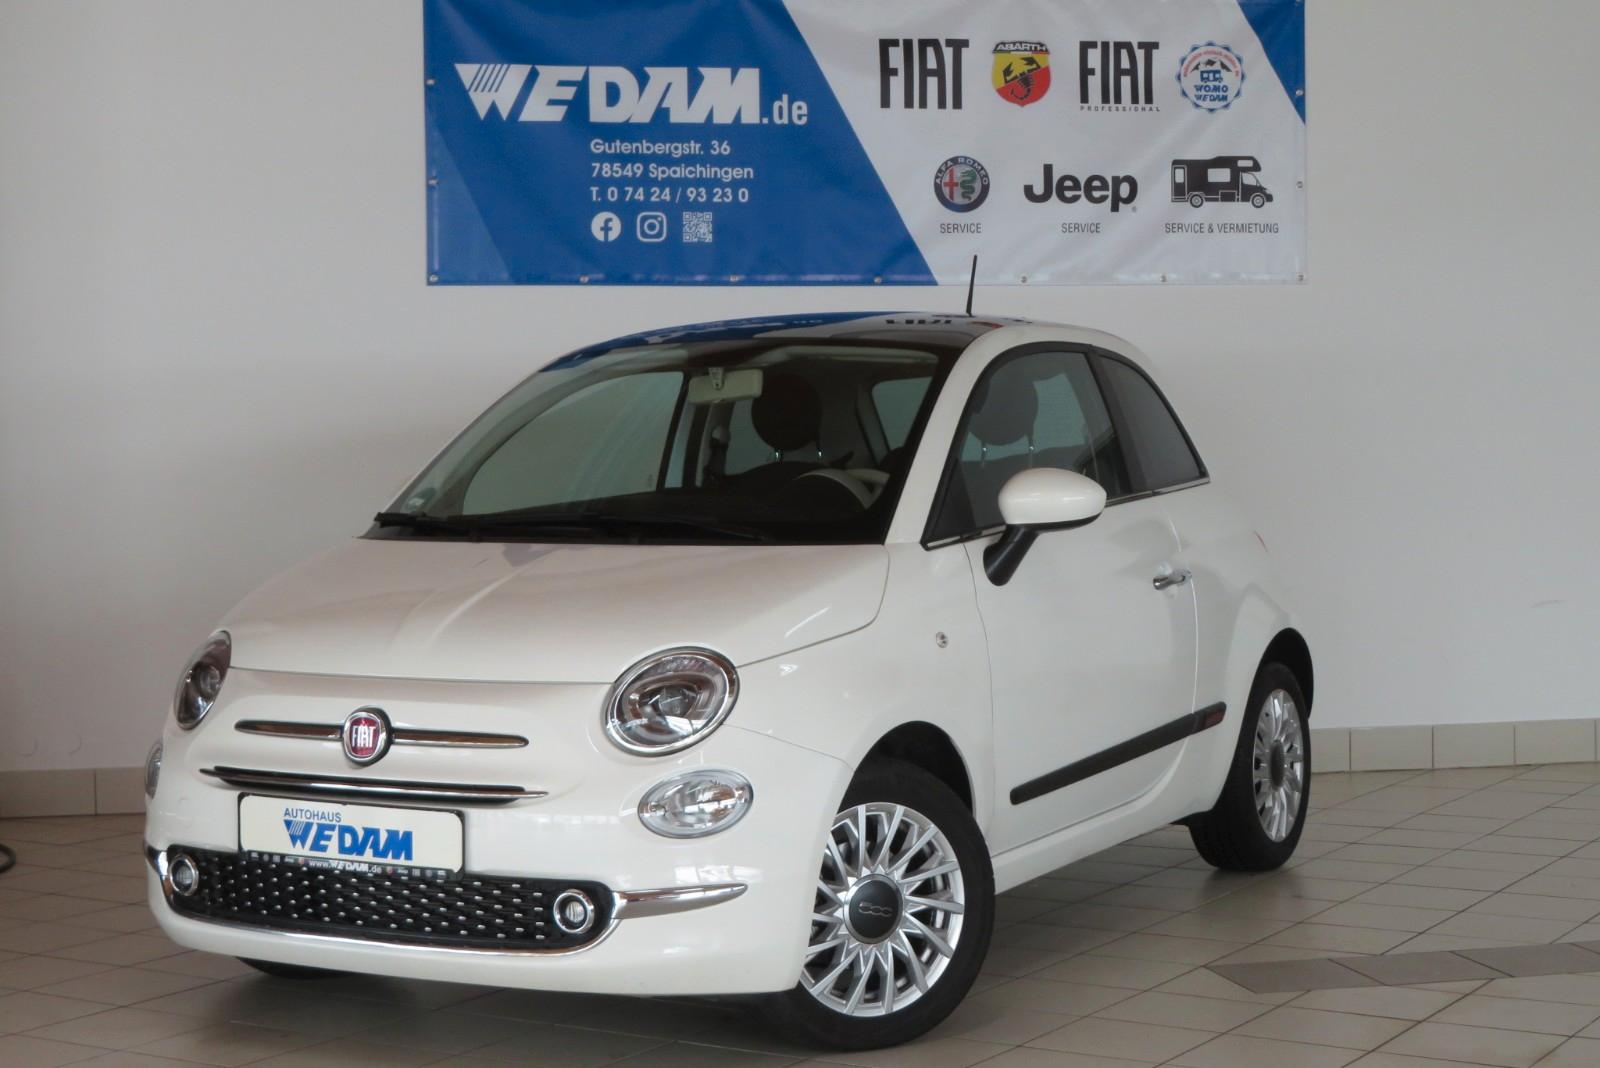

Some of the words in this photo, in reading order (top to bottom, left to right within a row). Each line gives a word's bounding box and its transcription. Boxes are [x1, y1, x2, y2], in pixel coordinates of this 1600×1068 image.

[997, 42, 1048, 52] ABARTH
[878, 38, 970, 110] FIAT
[1079, 40, 1160, 105] FIAT
[590, 139, 704, 158] Gutenbergstr.
[710, 140, 731, 155] 36
[591, 163, 644, 178] 78549
[648, 163, 754, 182] Spaichingen
[935, 160, 954, 184] ALFA
[958, 157, 989, 185] ROMEO
[590, 186, 601, 202] T.
[607, 186, 618, 201] 0
[624, 186, 645, 201] 74
[650, 187, 671, 201] 24
[675, 187, 682, 203] /
[687, 187, 707, 202] 93
[712, 187, 733, 202] 23
[738, 188, 749, 202] 0
[1023, 164, 1139, 213] Jeep
[939, 223, 982, 234] SERVICE
[1061, 223, 1101, 234] SERVICE
[1165, 223, 1204, 234] SERVICE
[1208, 223, 1215, 234] &
[1217, 223, 1279, 234] VERMIETUNG
[352, 724, 376, 748] FIAT
[283, 807, 342, 822] AUTOHAUS
[283, 819, 413, 861] WEDAM
